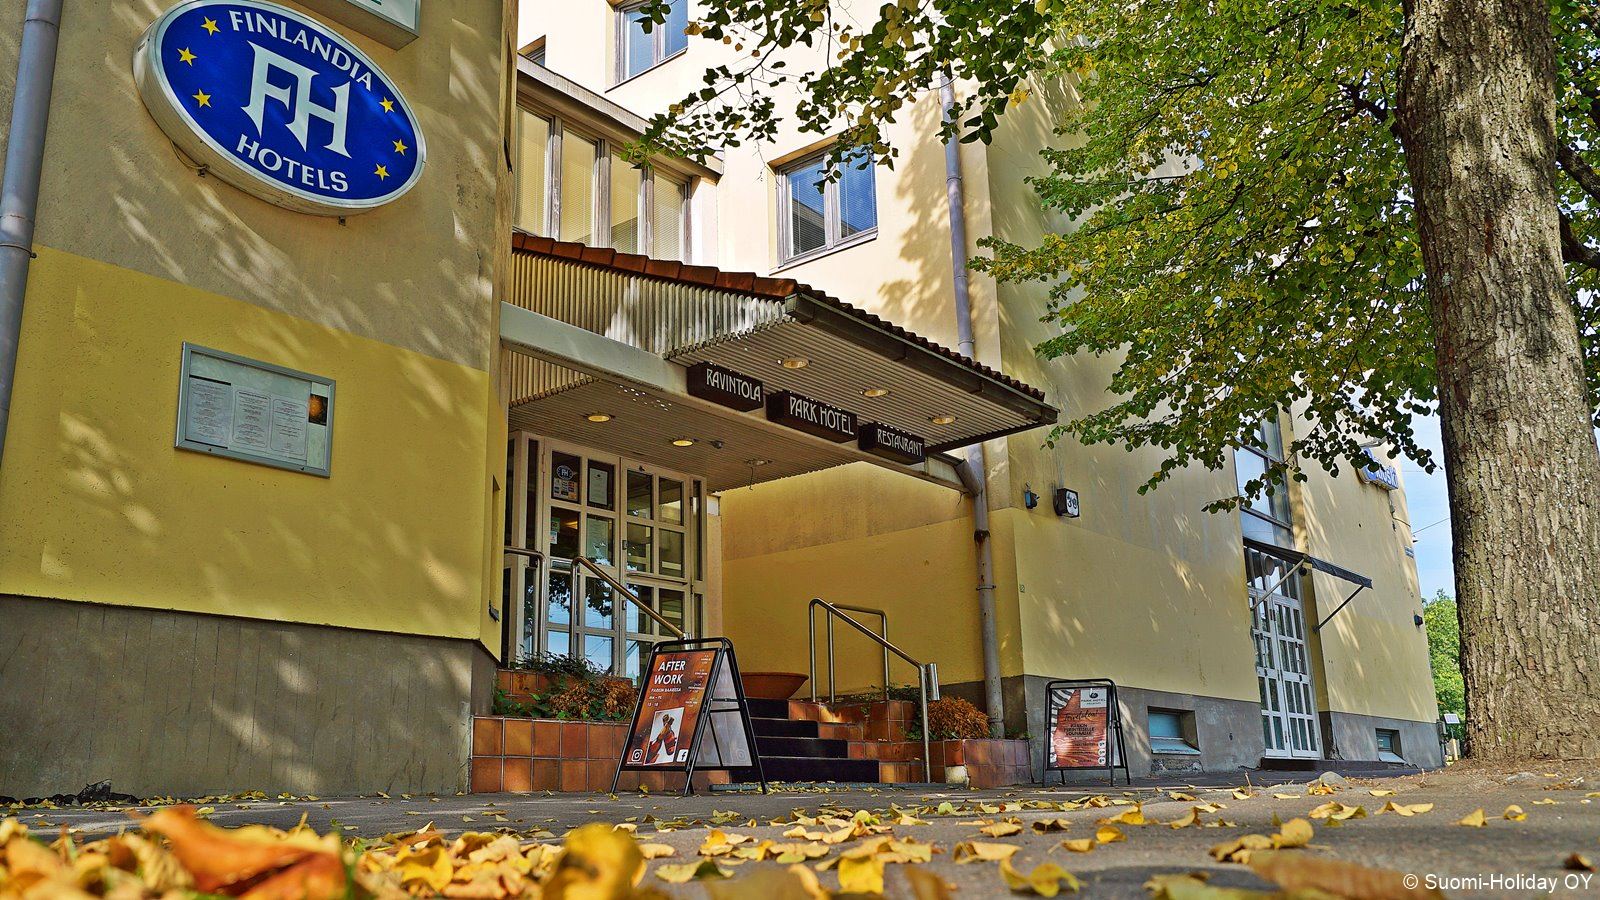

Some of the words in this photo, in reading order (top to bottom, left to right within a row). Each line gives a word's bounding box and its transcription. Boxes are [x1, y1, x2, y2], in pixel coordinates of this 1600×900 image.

[229, 10, 372, 91] FINLANDIA
[241, 40, 352, 159] FH
[236, 133, 349, 192] HOTELS
[706, 368, 761, 402] RAVINTOLA
[789, 396, 817, 424] PARK
[820, 407, 855, 435] HOTEL
[877, 428, 923, 457] RESTAURANT
[654, 674, 683, 685] WORK
[658, 661, 686, 672] AFTER
